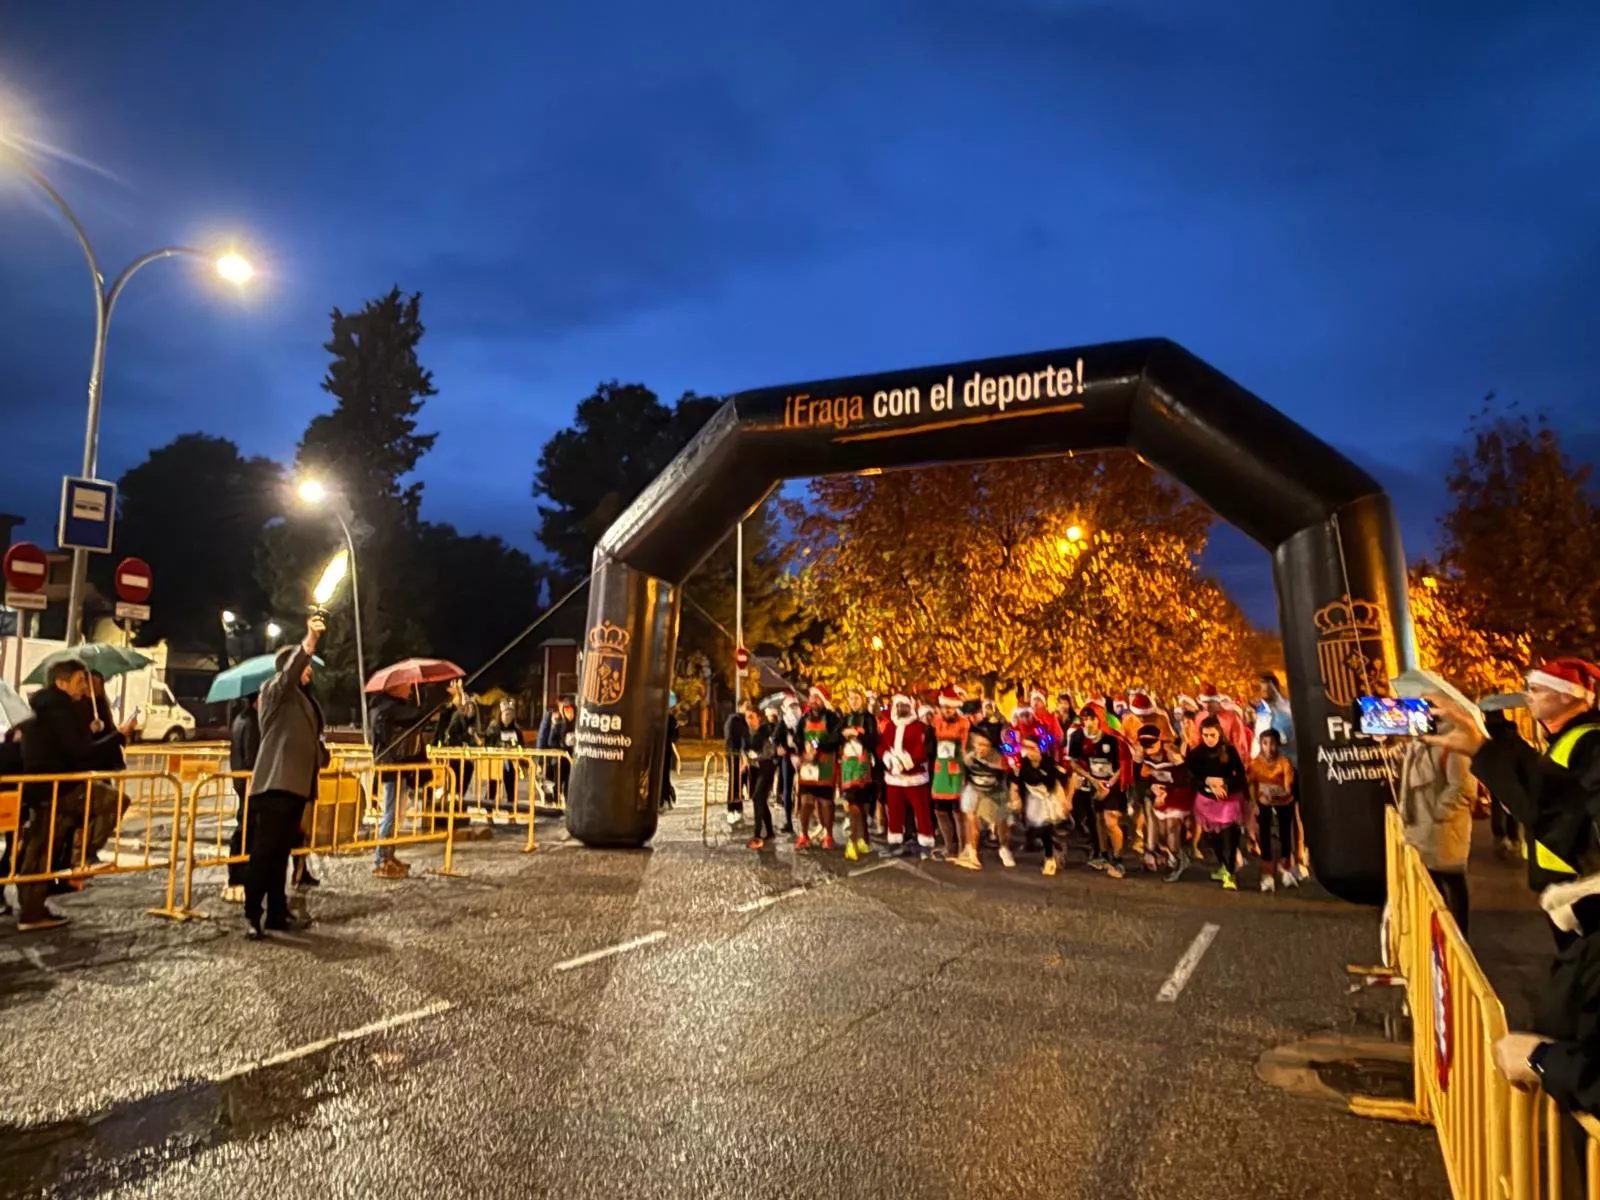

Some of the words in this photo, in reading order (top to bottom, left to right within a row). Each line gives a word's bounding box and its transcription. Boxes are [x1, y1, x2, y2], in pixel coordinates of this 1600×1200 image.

[784, 394, 864, 430] ¡Fraga
[872, 386, 921, 418] con
[930, 373, 954, 412] el
[963, 357, 1084, 412] deporte!
[579, 706, 622, 732] Fraga
